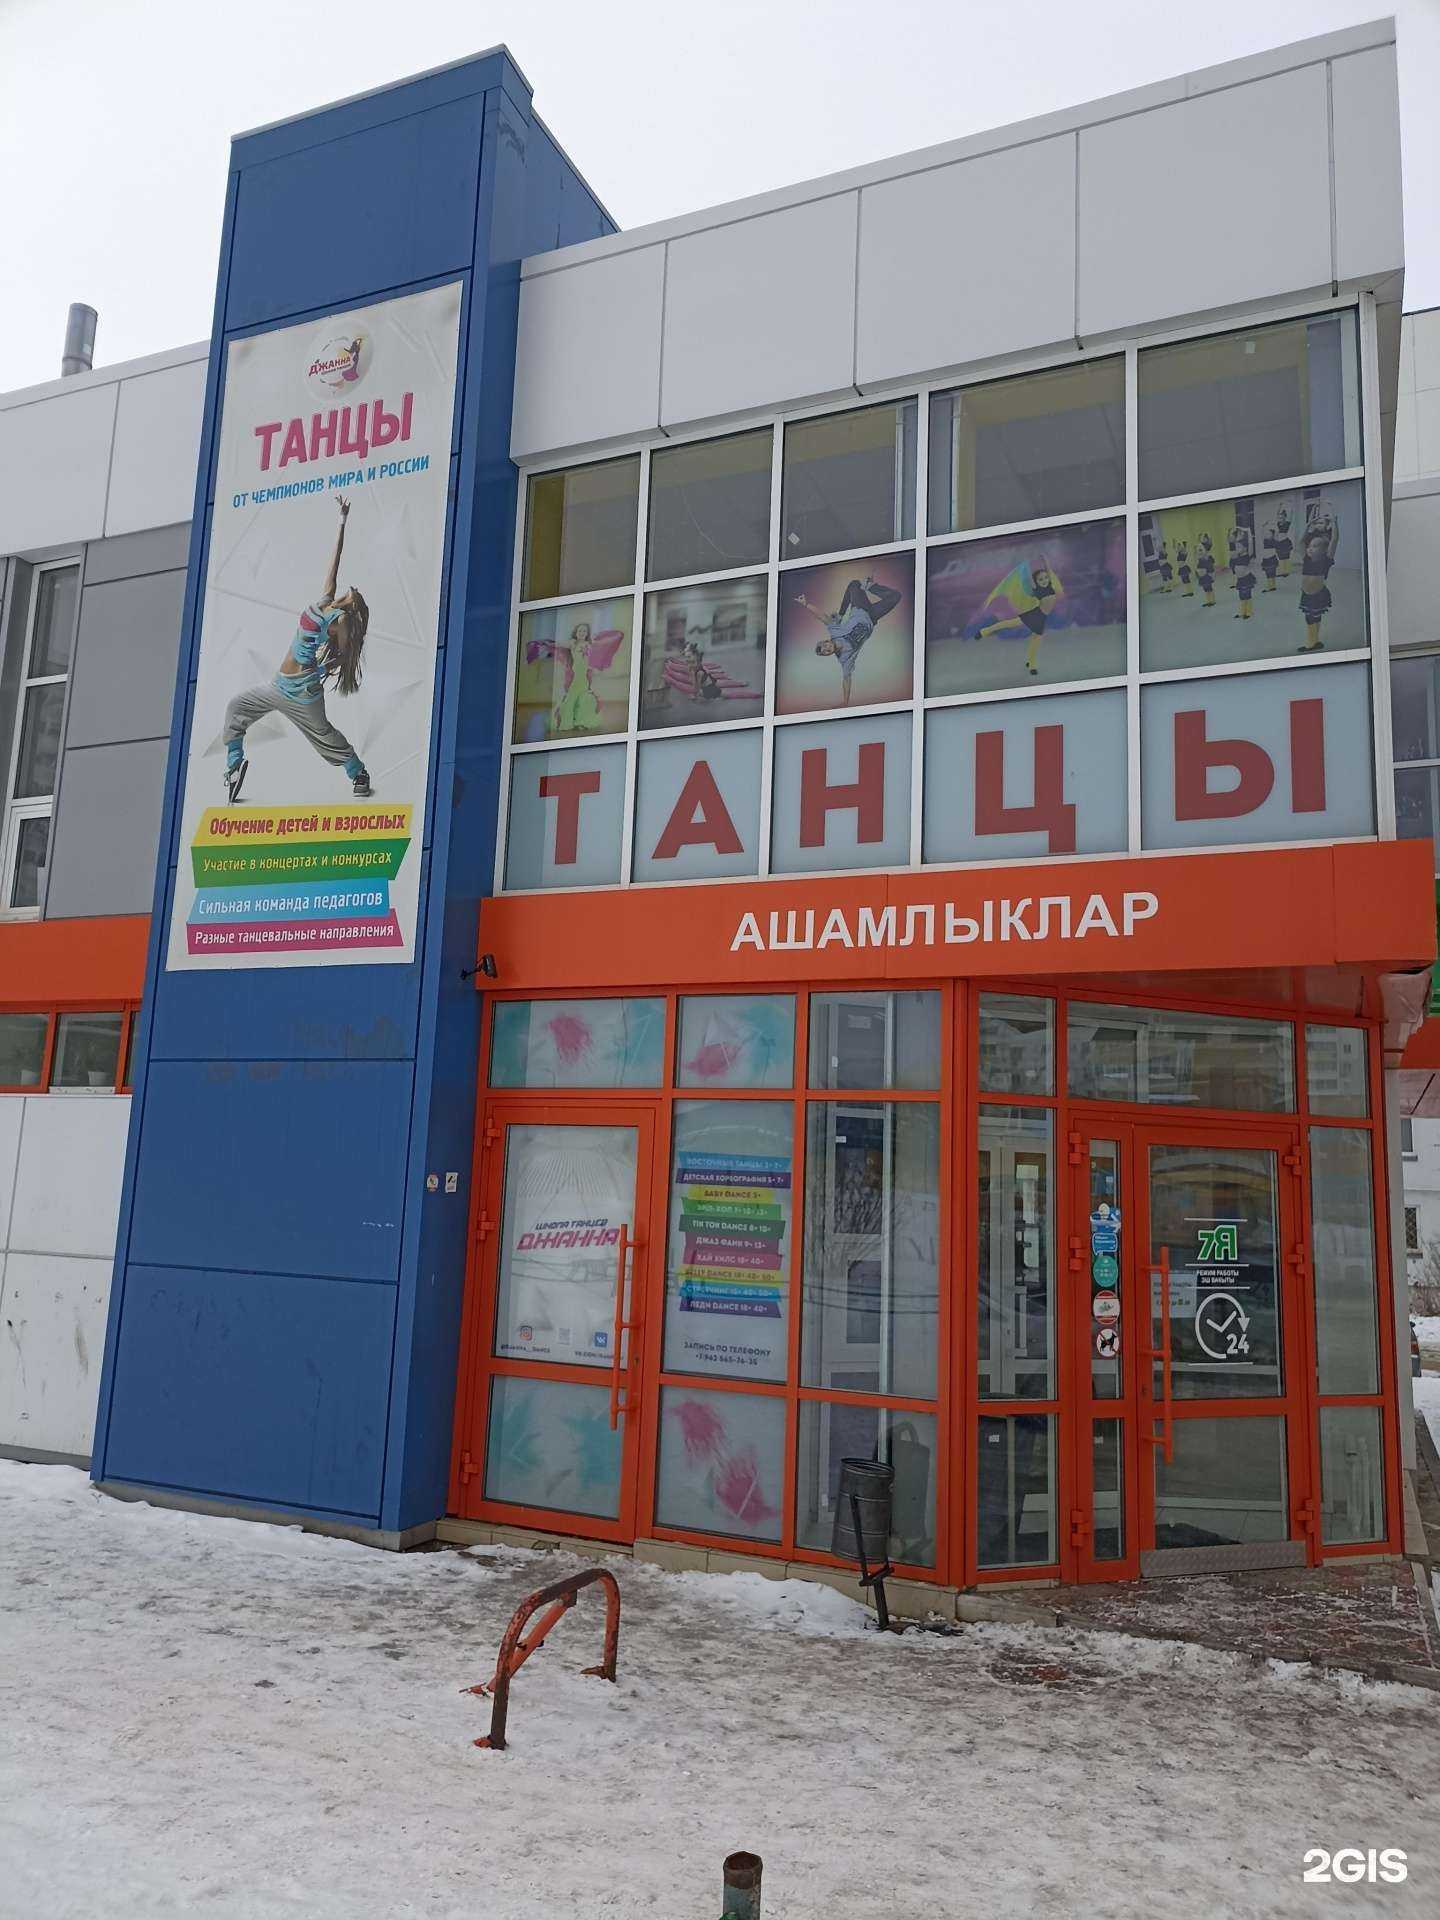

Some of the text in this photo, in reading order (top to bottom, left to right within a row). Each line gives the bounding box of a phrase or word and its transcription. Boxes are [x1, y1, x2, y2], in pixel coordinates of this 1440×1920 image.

[255, 392, 414, 471] ТАНЦЫ
[232, 455, 430, 508] ОТ ЧЕМПИОНОВ МИРА И РОССИИ
[539, 698, 1327, 865] ТАНЦЫ
[210, 813, 405, 837] Обучение детей и взрослых
[204, 852, 392, 872] Участие в концертах и конкурсах
[199, 891, 383, 915] Сильная команда педагогов
[729, 891, 1159, 952] АШАМЛЫКЛАР
[195, 924, 394, 944] Разные танцевальные направления
[1197, 1225, 1238, 1261] 7Я
[684, 1341, 771, 1357] ЗАПИСЬ ПО ТЕЛЕФОНУ
[1226, 1333, 1250, 1354] 24
